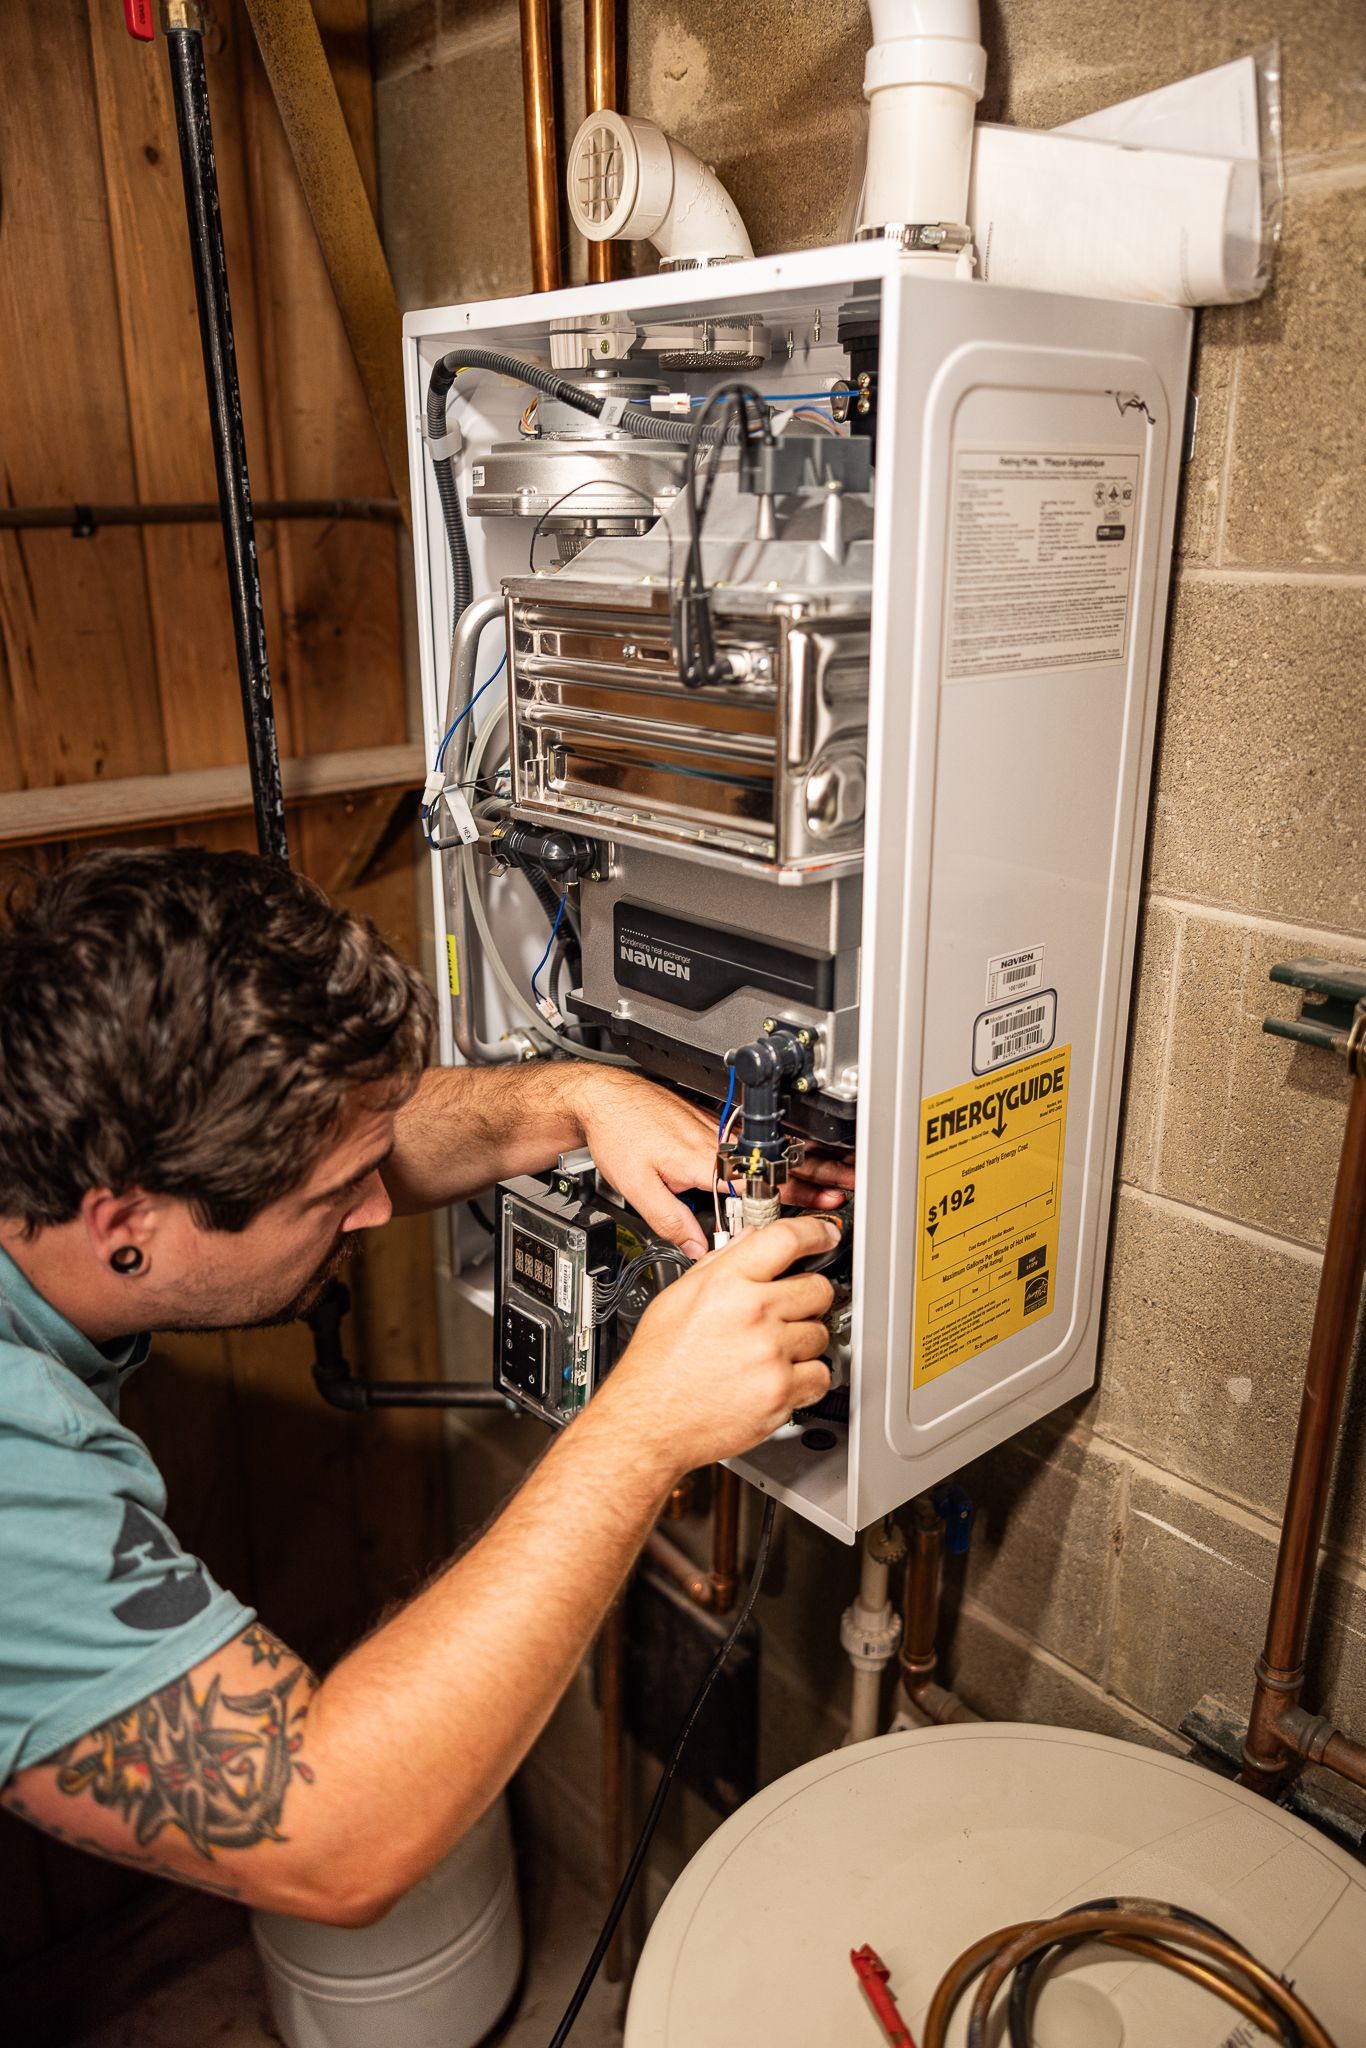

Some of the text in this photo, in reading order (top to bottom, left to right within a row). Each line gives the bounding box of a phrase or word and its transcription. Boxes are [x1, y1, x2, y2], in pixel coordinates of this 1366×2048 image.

[462, 826, 472, 840] HEX
[620, 935, 651, 953] Condensing
[664, 948, 691, 964] exchanger
[926, 1066, 1066, 1146] ENERGYGUIDE
[962, 1142, 1029, 1178] Estimated Yearly Energy Cost
[928, 1182, 976, 1225] $192
[943, 1230, 1037, 1283] Maximum Gallons Per Minute of Hot Water
